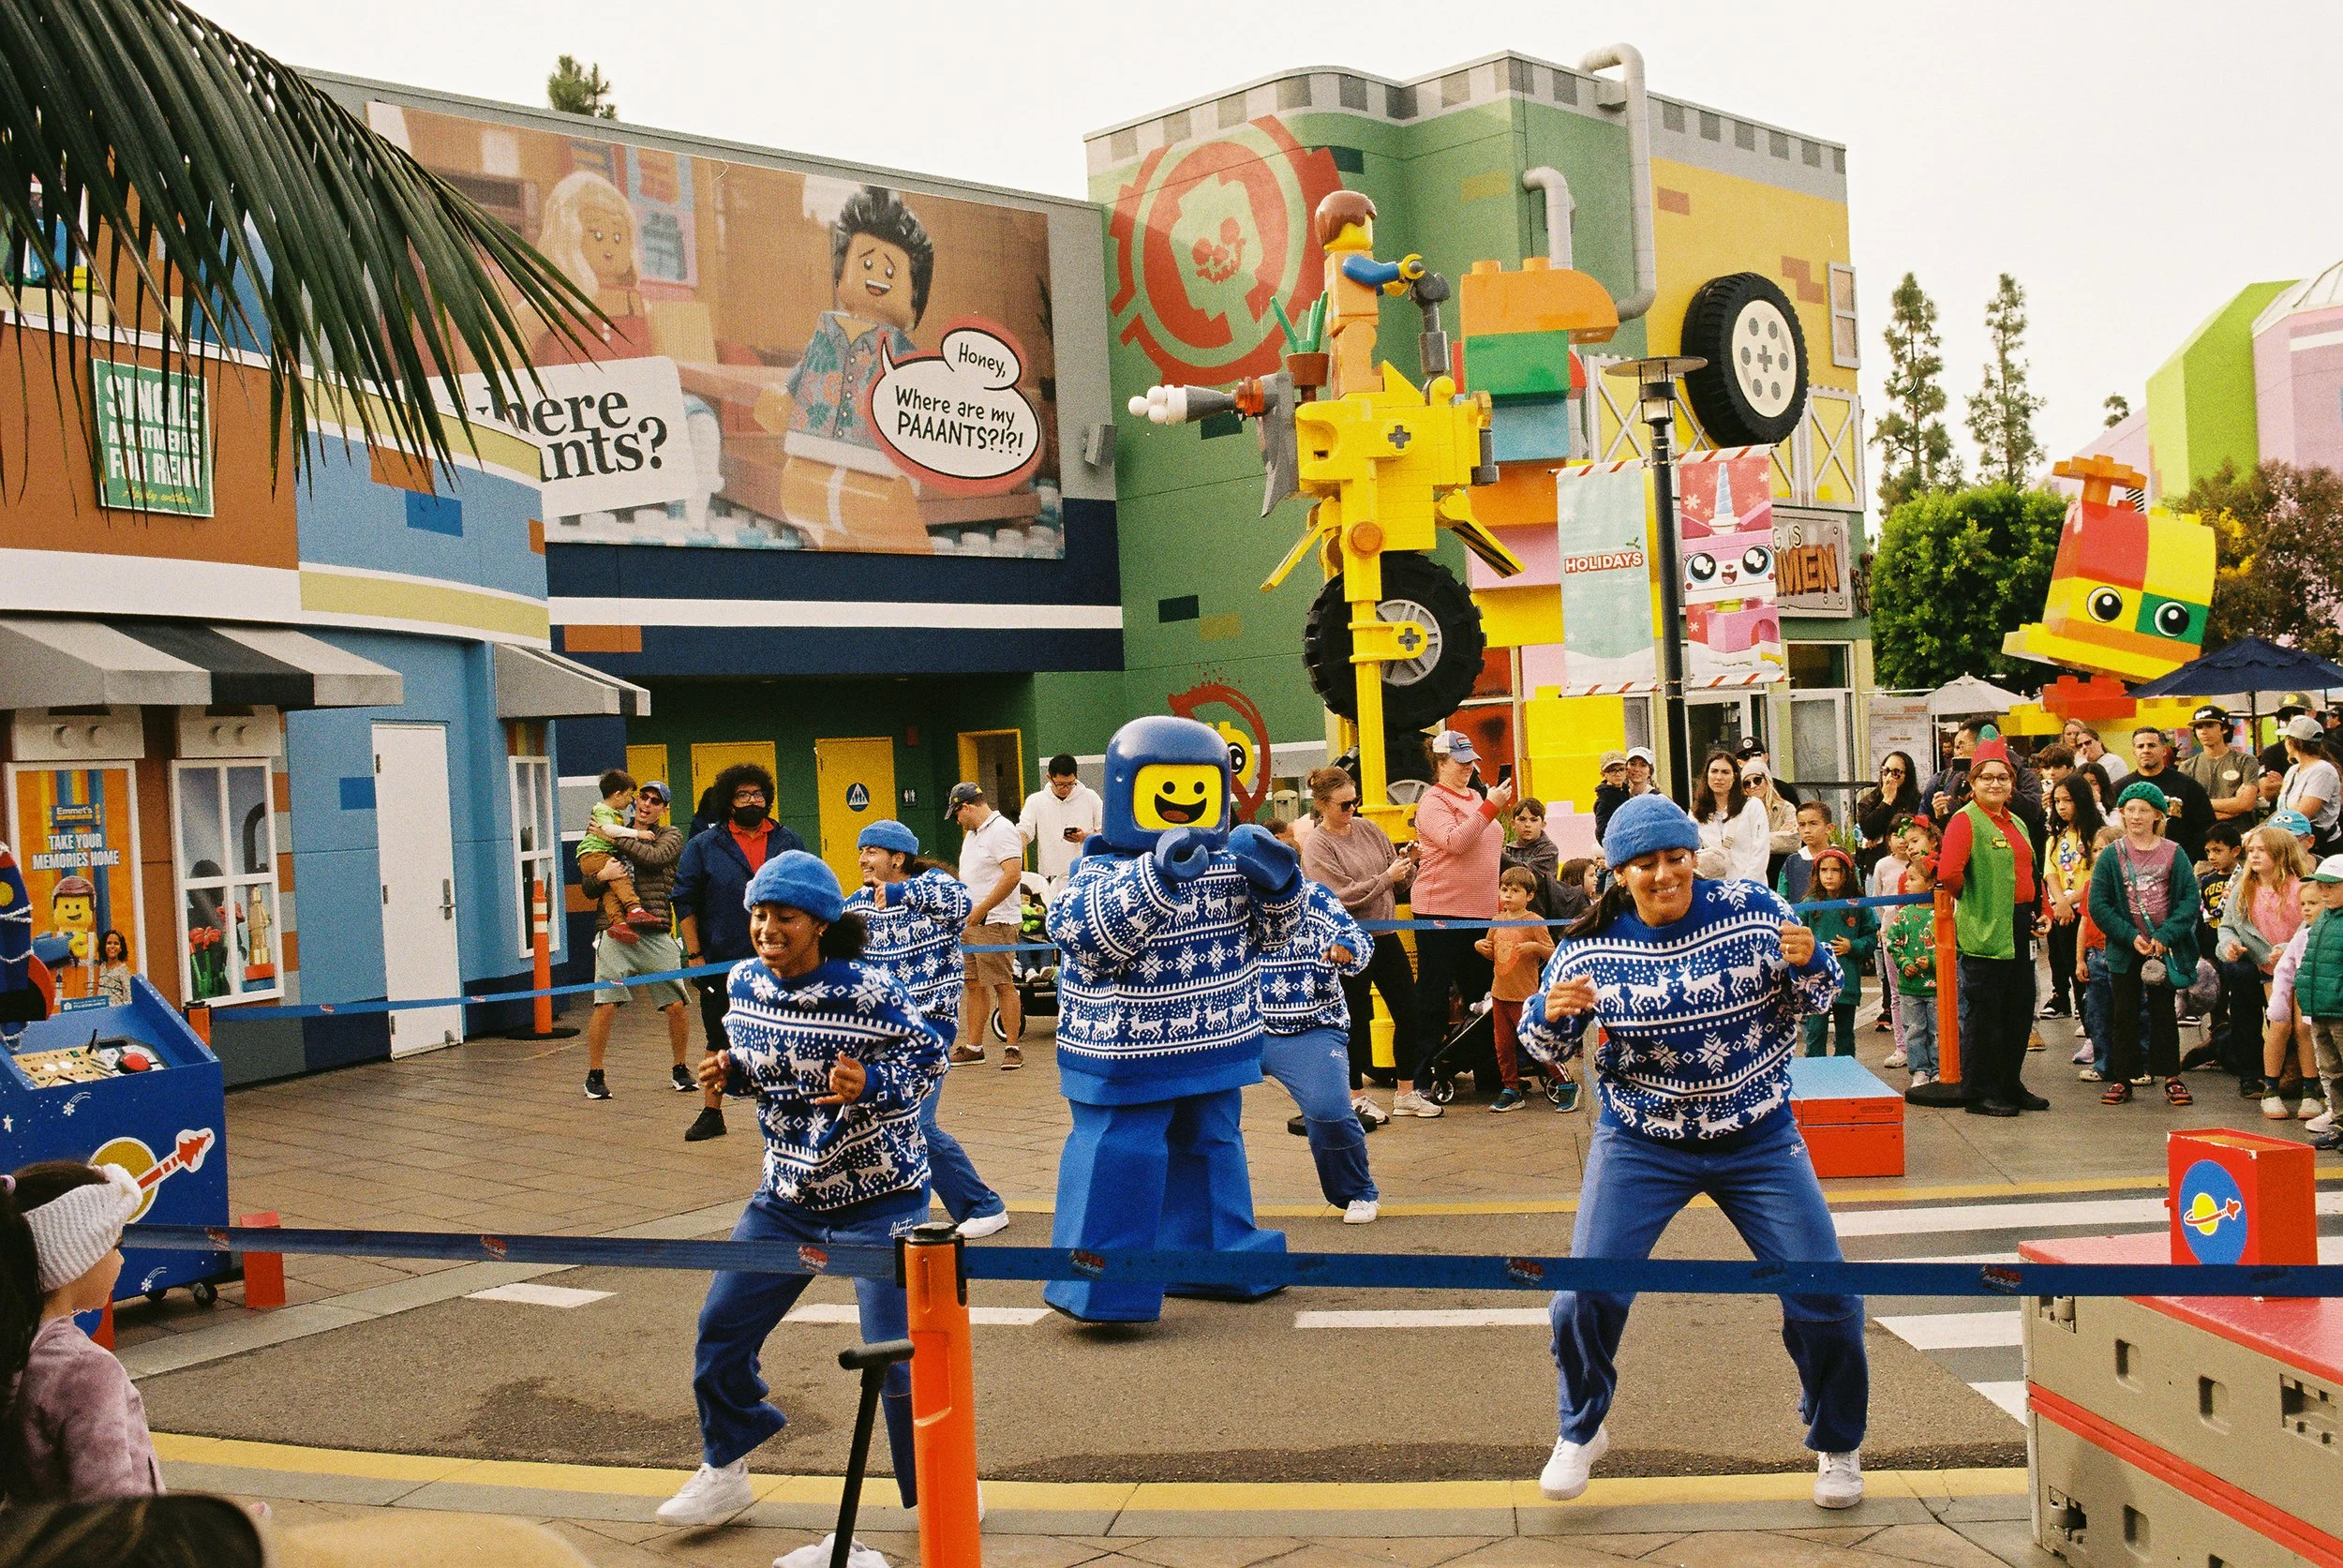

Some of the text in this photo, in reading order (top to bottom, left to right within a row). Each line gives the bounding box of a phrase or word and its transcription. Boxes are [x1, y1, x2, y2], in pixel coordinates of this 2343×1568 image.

[958, 342, 1006, 378] Honey,
[105, 375, 201, 429] SINGLE
[476, 386, 631, 437] here
[895, 385, 1015, 431] Where are my
[897, 410, 1023, 456] PAAANTS?!?!
[110, 447, 201, 488] FOR RENT
[1564, 551, 1644, 574] HOLIDAYS
[56, 806, 93, 815] Emmet's
[32, 850, 120, 871] MEMORIES HOME
[48, 833, 102, 851] TAKE YOUR
